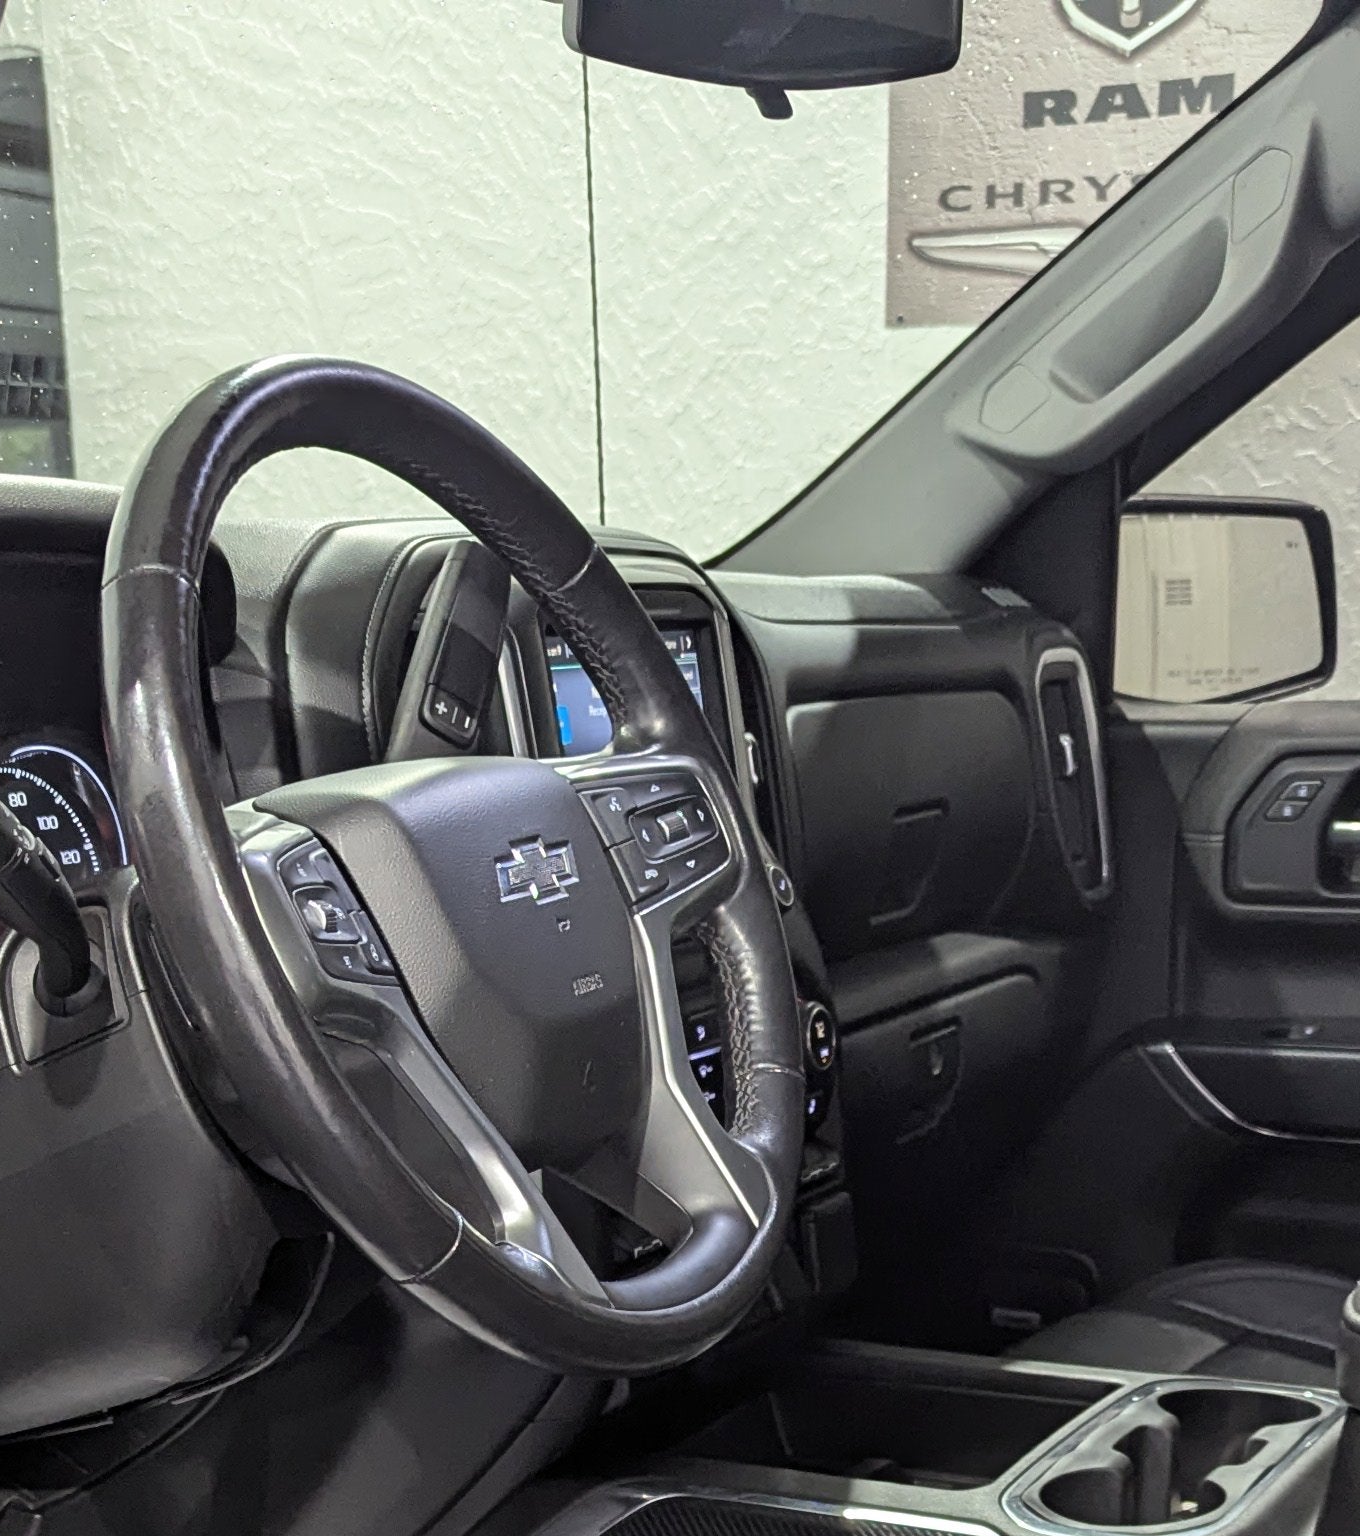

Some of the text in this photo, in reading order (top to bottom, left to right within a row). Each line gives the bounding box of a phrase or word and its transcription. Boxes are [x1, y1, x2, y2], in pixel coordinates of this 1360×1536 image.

[1023, 73, 1235, 129] RAM
[938, 173, 1148, 212] CHRY
[8, 791, 27, 808] 80
[37, 815, 59, 831] 100
[60, 849, 81, 865] 120
